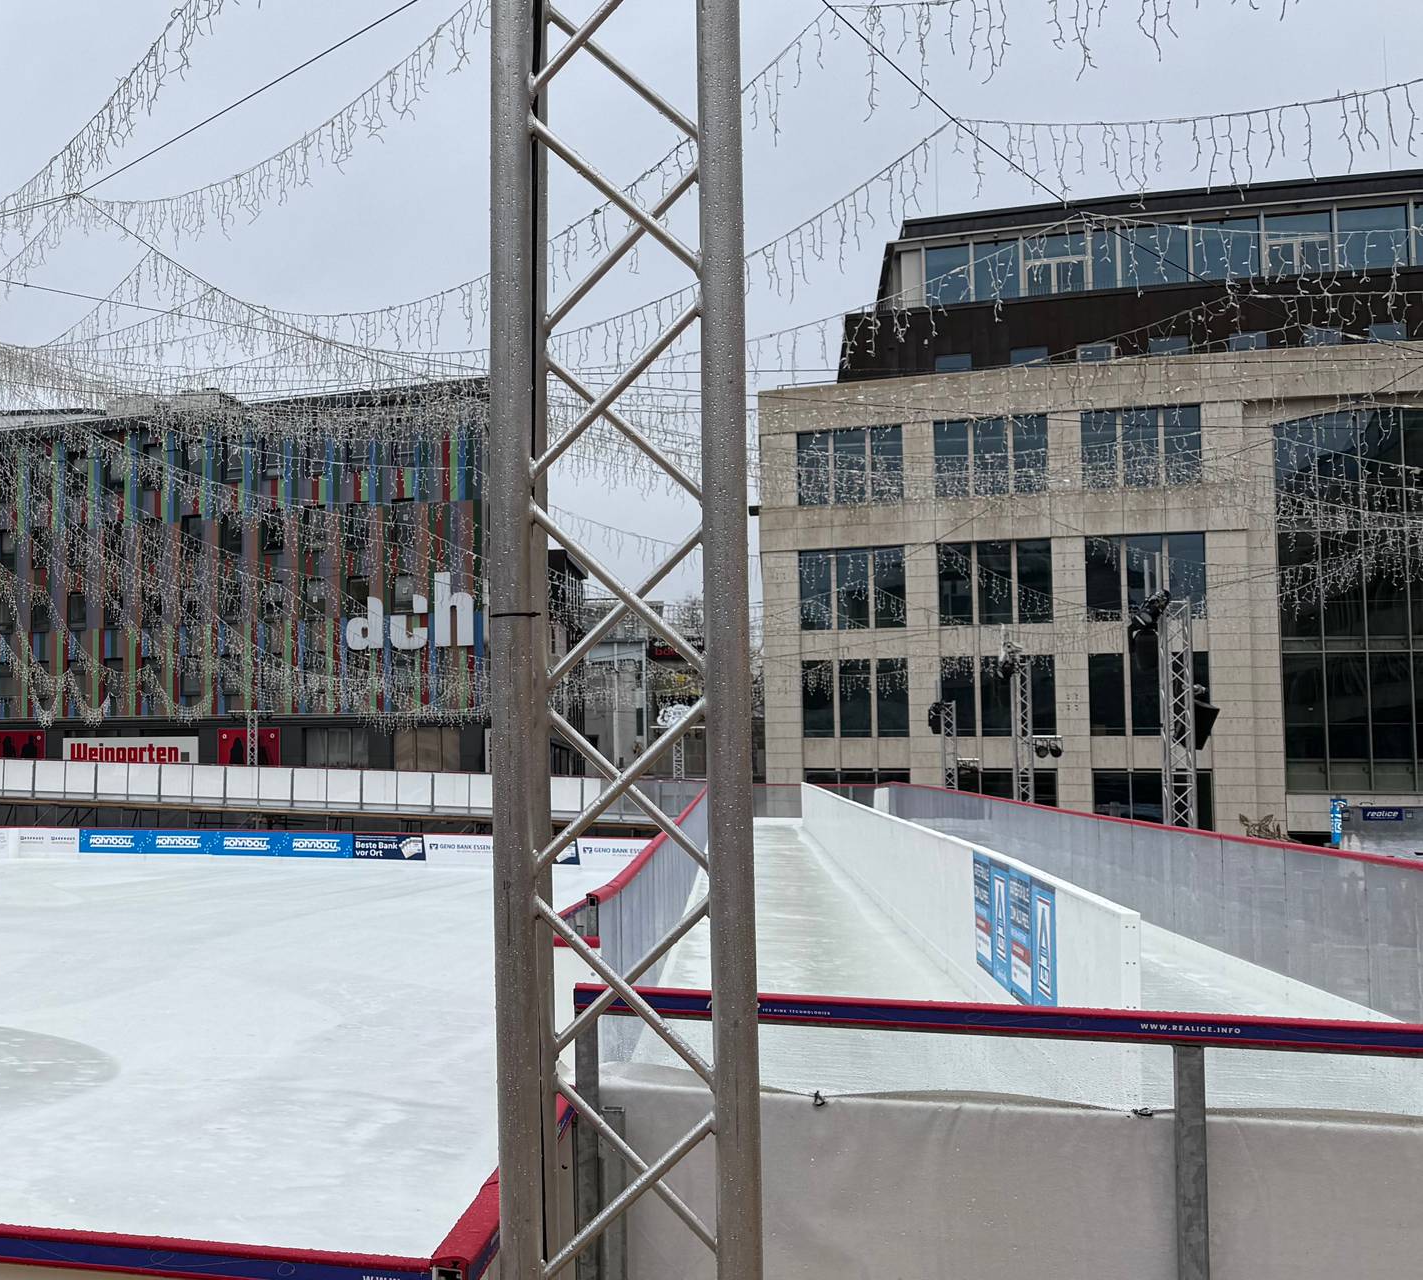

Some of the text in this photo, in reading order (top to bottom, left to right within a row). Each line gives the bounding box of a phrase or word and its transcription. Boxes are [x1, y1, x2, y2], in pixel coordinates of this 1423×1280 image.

[355, 841, 398, 850] Beste Bank
[370, 849, 383, 857] Ort
[1140, 1023, 1241, 1034] WWW.REALICE.INFO
